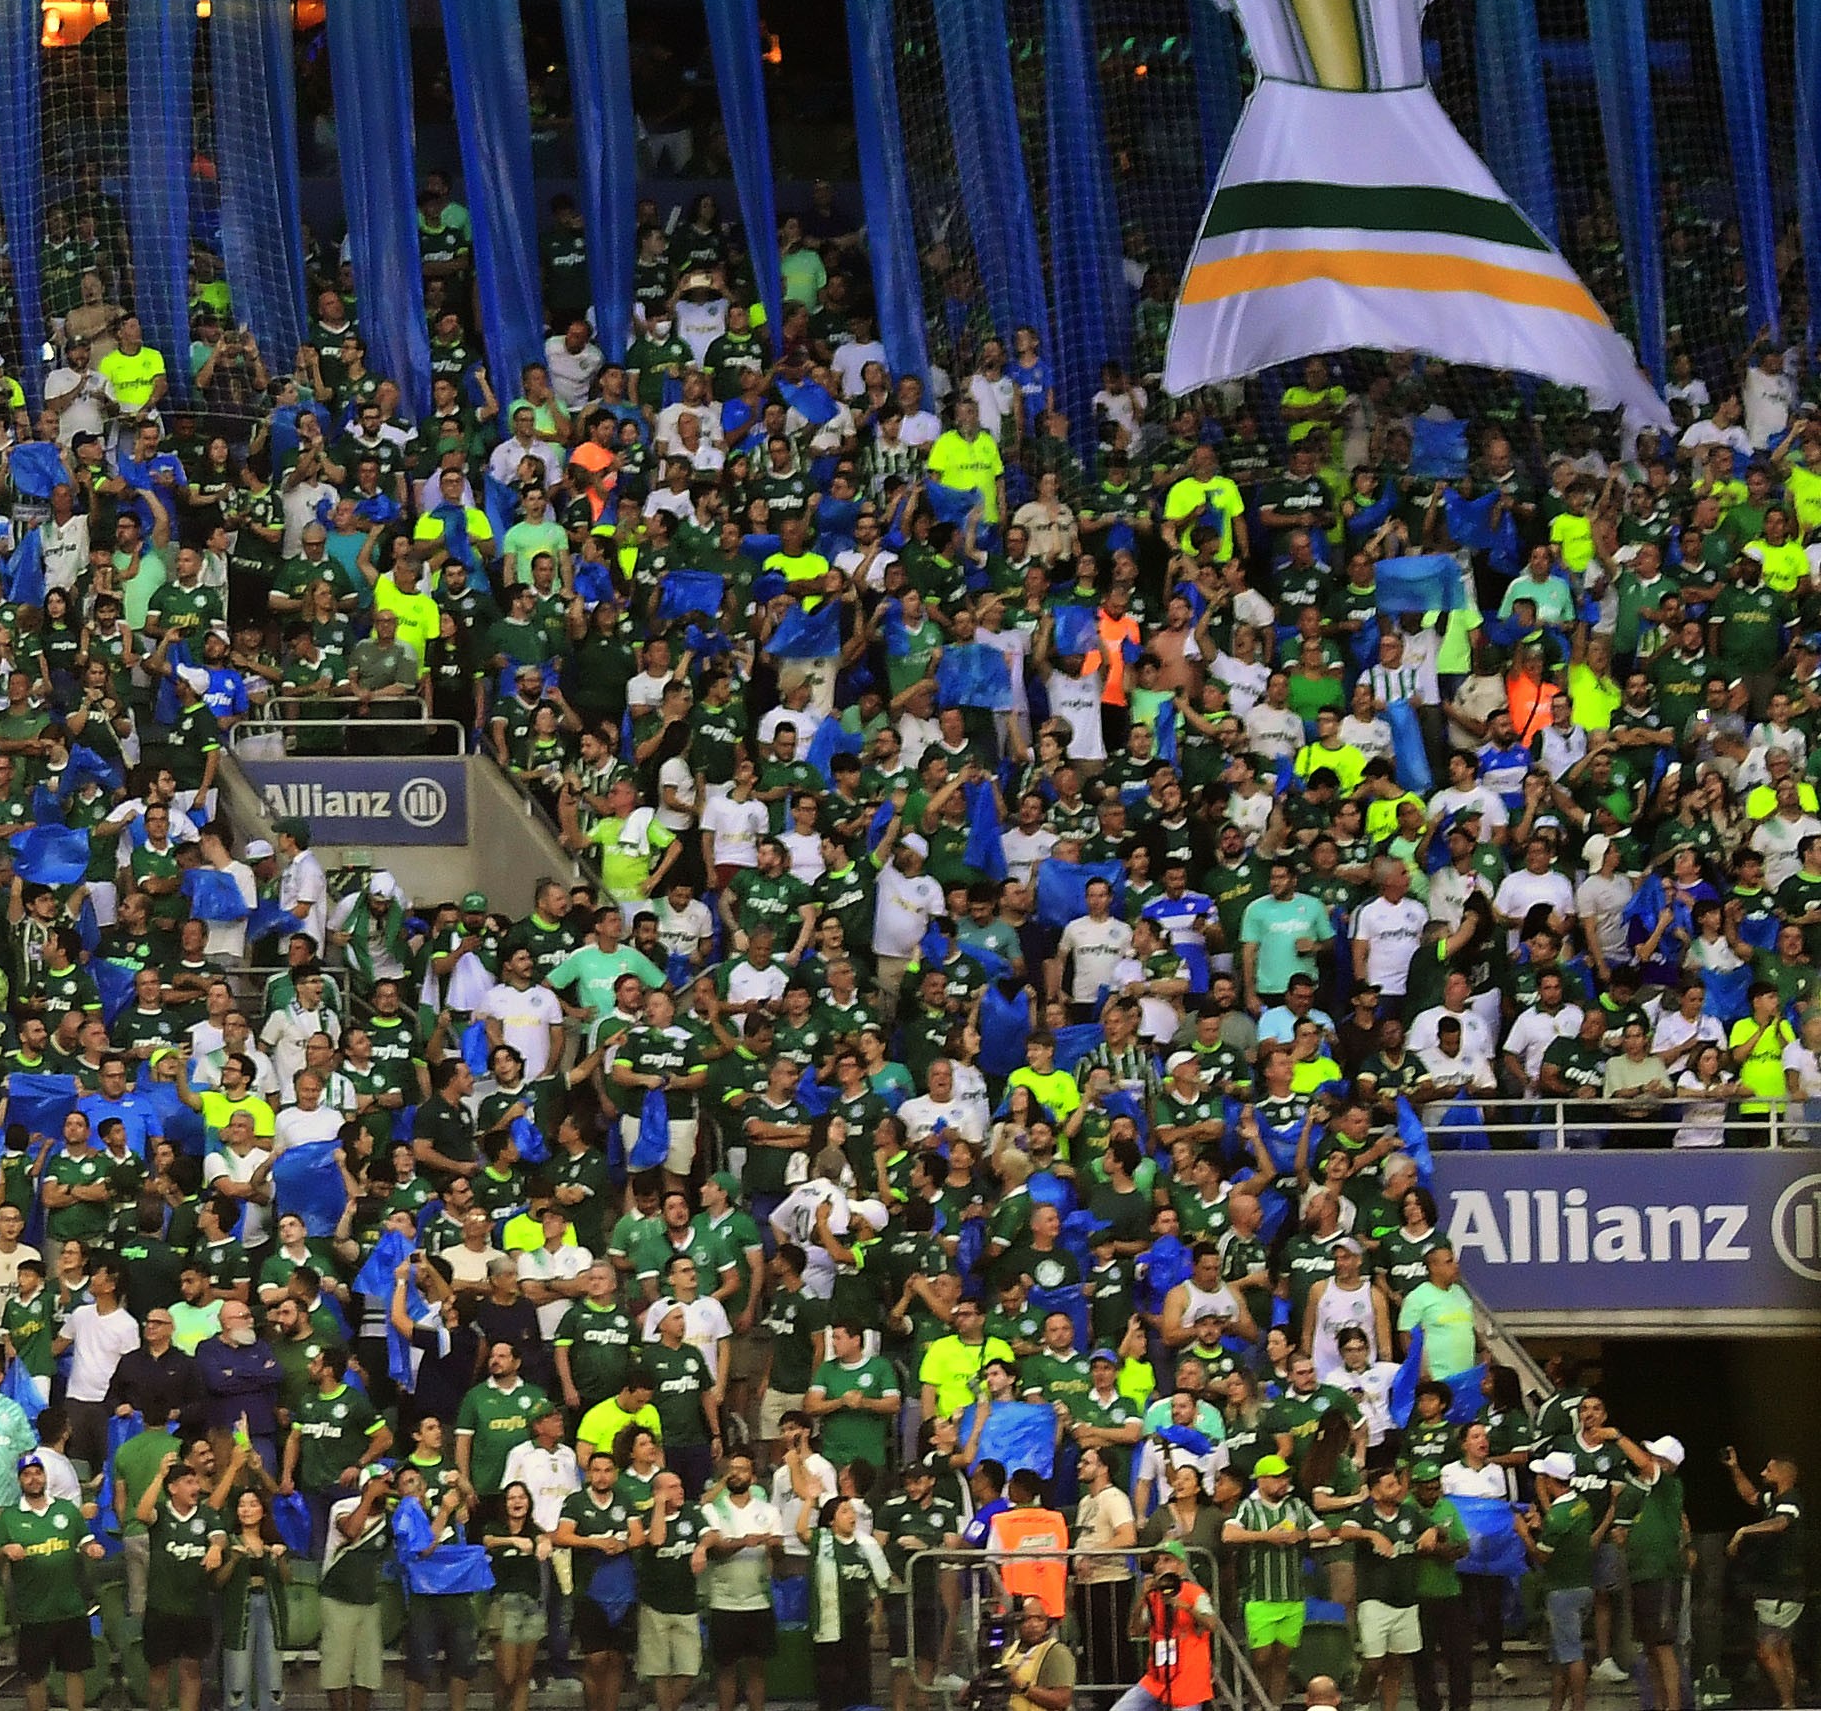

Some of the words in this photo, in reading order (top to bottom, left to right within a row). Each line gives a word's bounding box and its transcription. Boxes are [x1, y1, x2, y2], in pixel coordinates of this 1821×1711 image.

[260, 782, 391, 820] Allianz
[401, 1048, 442, 1061] crefisa
[1446, 1188, 1751, 1266] Allianz
[584, 1329, 628, 1344] crefisa
[661, 1376, 699, 1393] crefisa
[291, 1422, 341, 1438] crefisa
[27, 1541, 70, 1555] crefisa
[165, 1541, 205, 1558] crefisa
